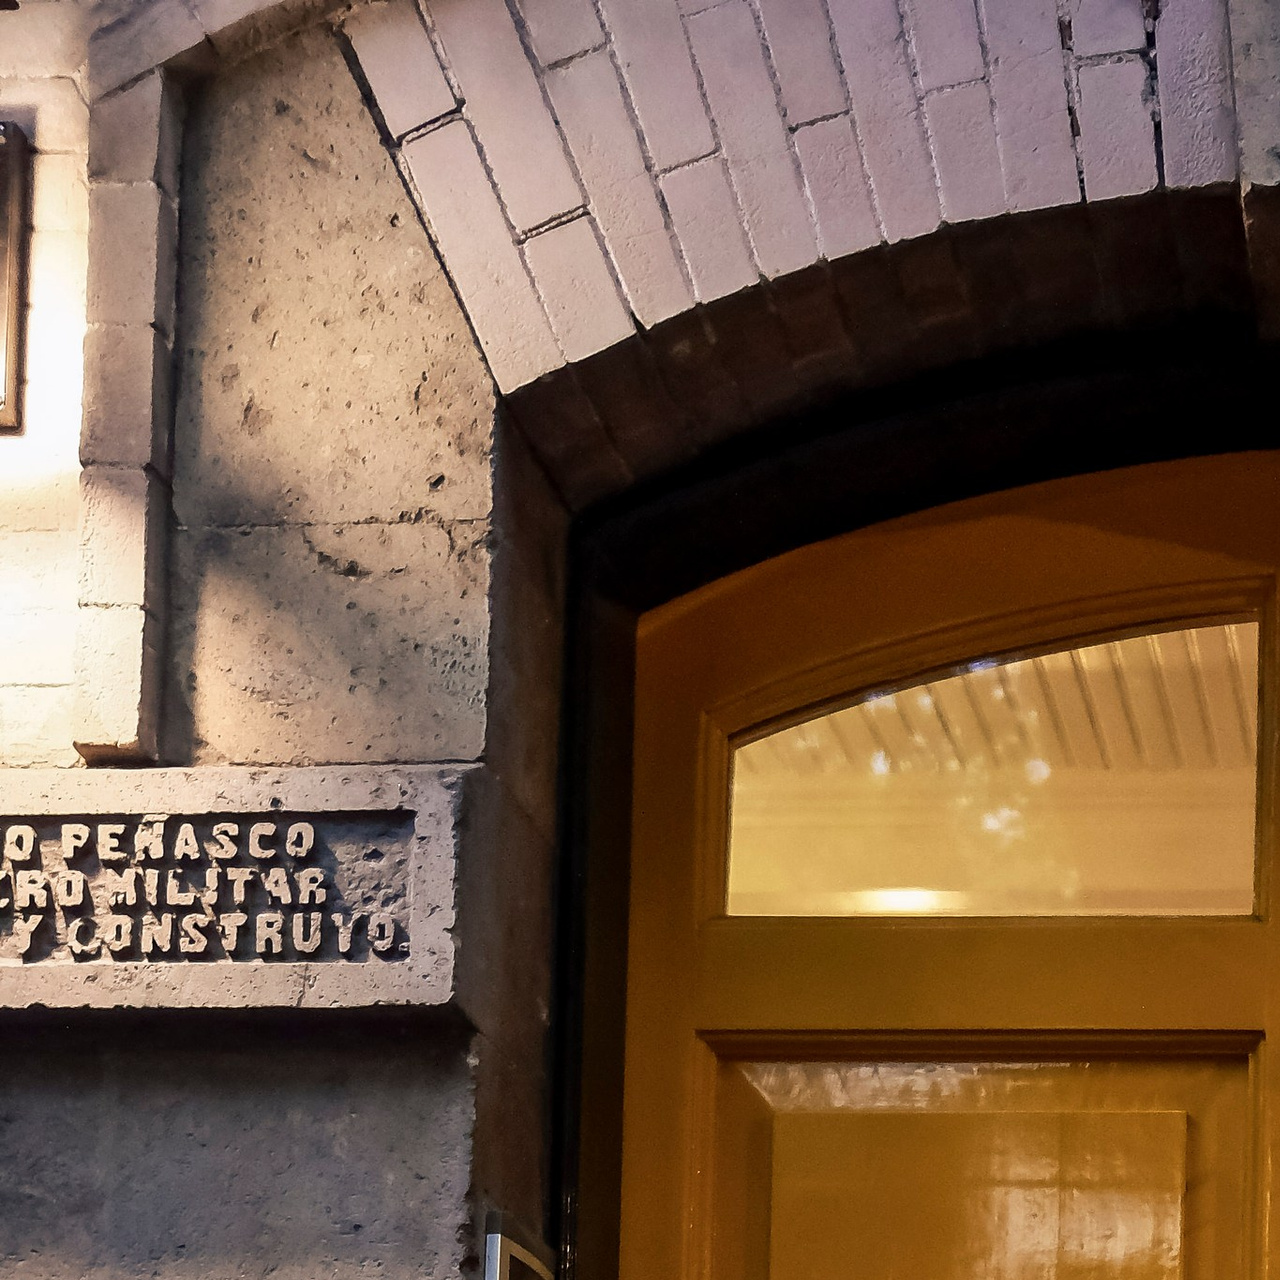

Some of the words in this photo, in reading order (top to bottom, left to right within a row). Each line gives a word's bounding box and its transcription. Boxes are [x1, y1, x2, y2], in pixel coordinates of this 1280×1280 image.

[5, 824, 37, 861] O
[61, 814, 315, 861] PEÑASCO
[0, 868, 86, 909] RO
[105, 867, 327, 906] MILITAR
